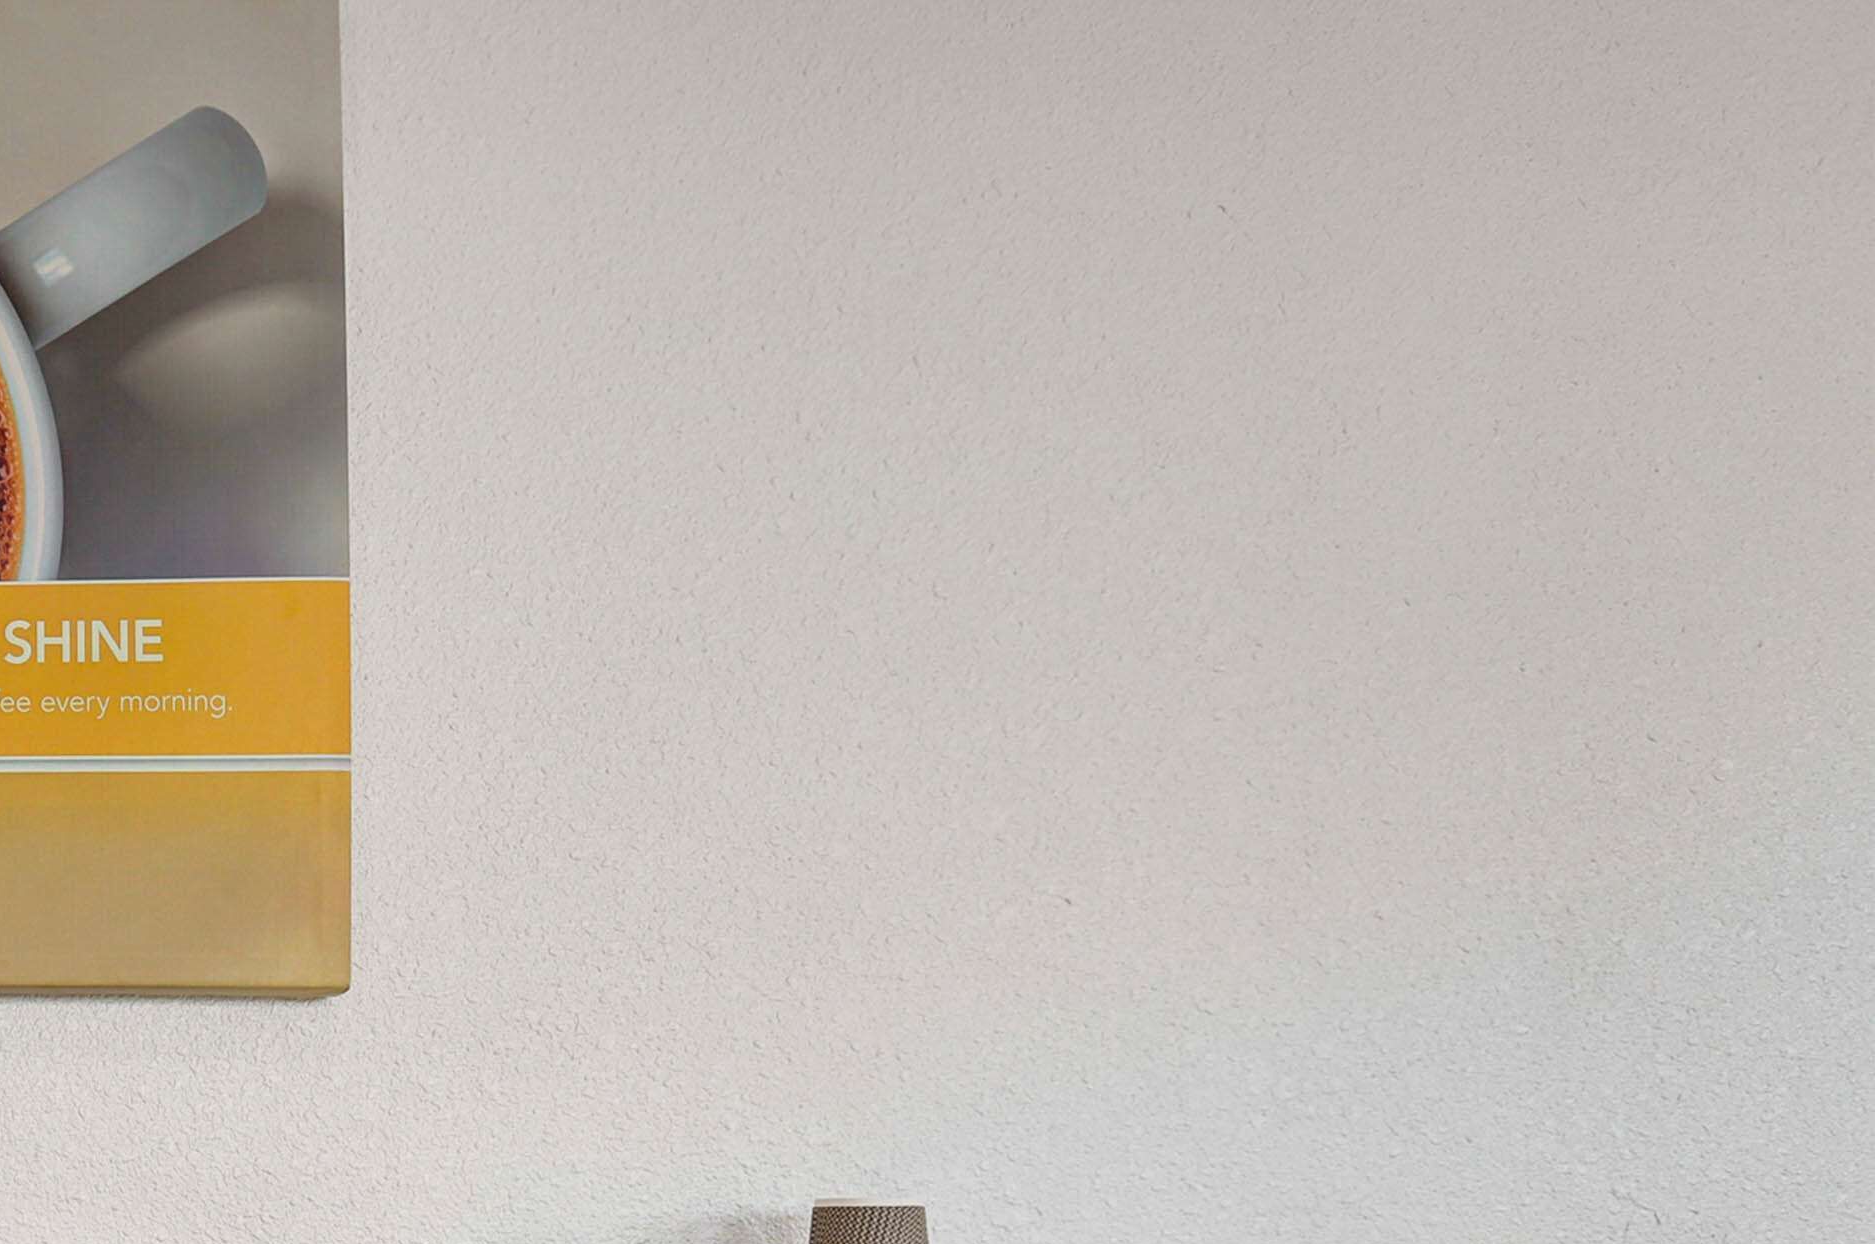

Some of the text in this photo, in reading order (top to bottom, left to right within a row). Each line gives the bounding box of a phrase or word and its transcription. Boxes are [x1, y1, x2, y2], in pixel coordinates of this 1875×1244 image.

[4, 619, 164, 664] SHINE
[40, 694, 110, 720] every
[120, 688, 233, 719] morning.
